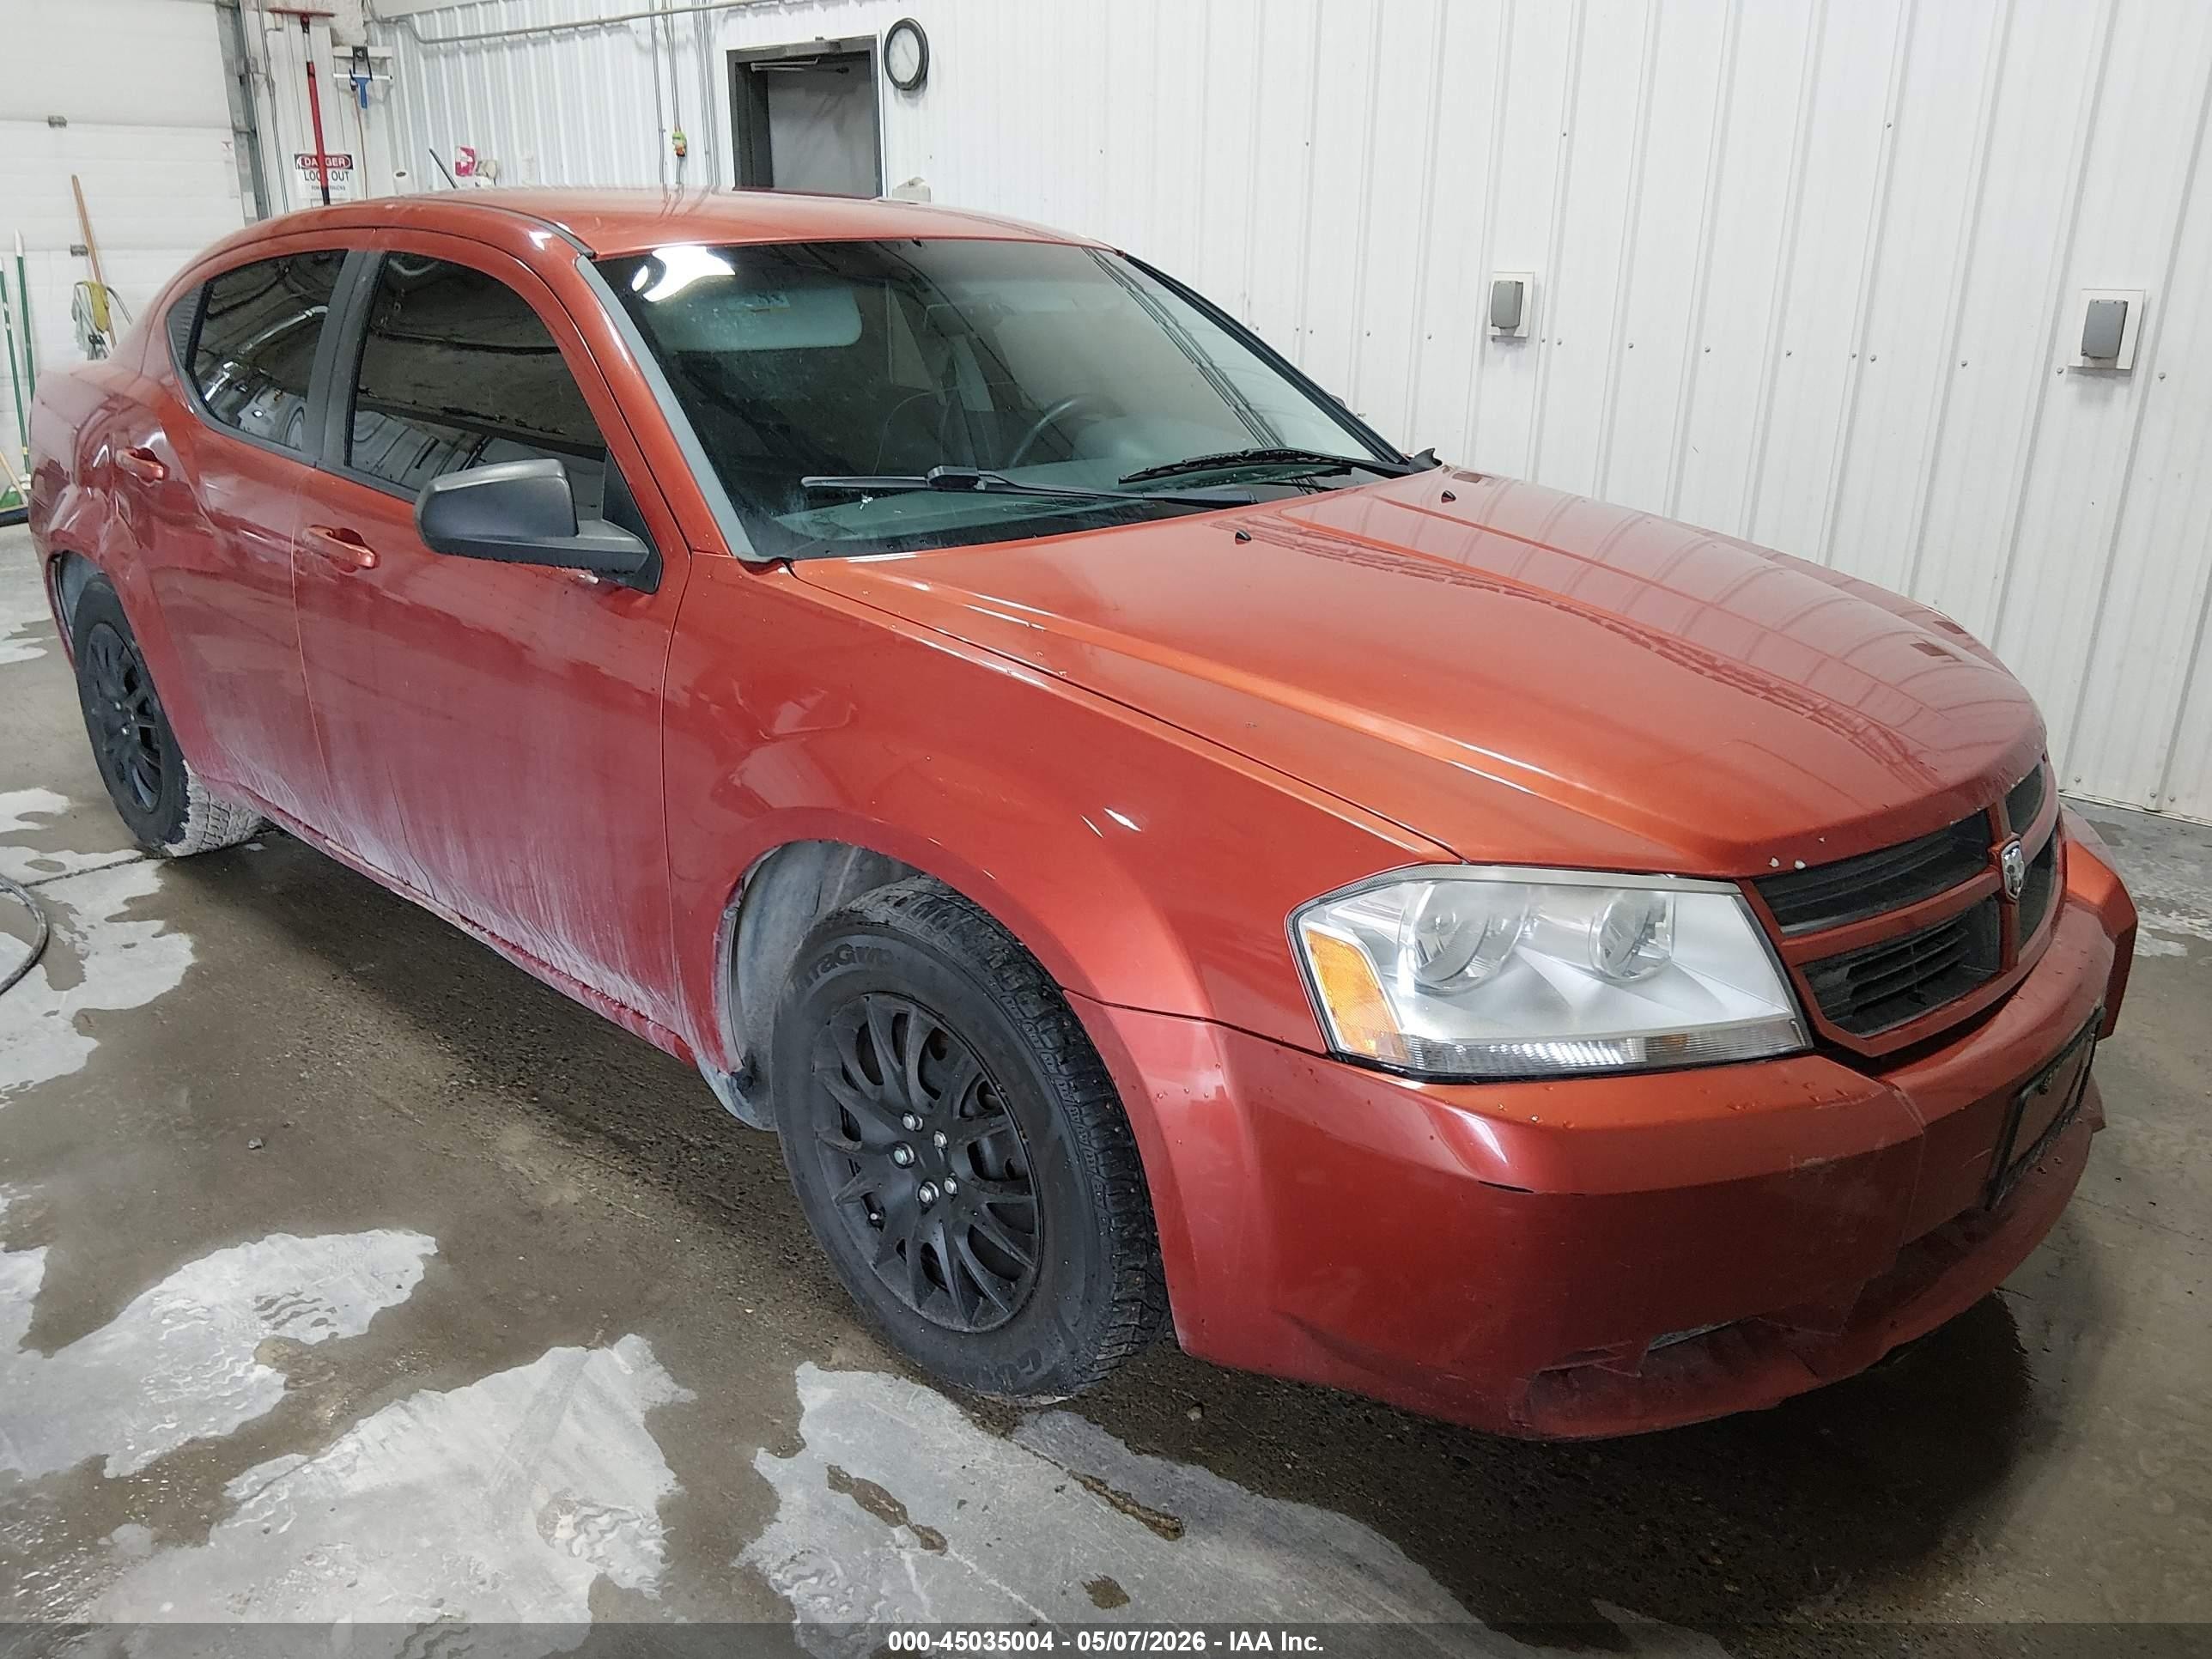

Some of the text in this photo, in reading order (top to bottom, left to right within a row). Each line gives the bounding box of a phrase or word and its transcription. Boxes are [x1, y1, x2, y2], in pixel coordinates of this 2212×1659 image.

[304, 157, 345, 167] DAGER
[304, 171, 349, 181] LOC OUT
